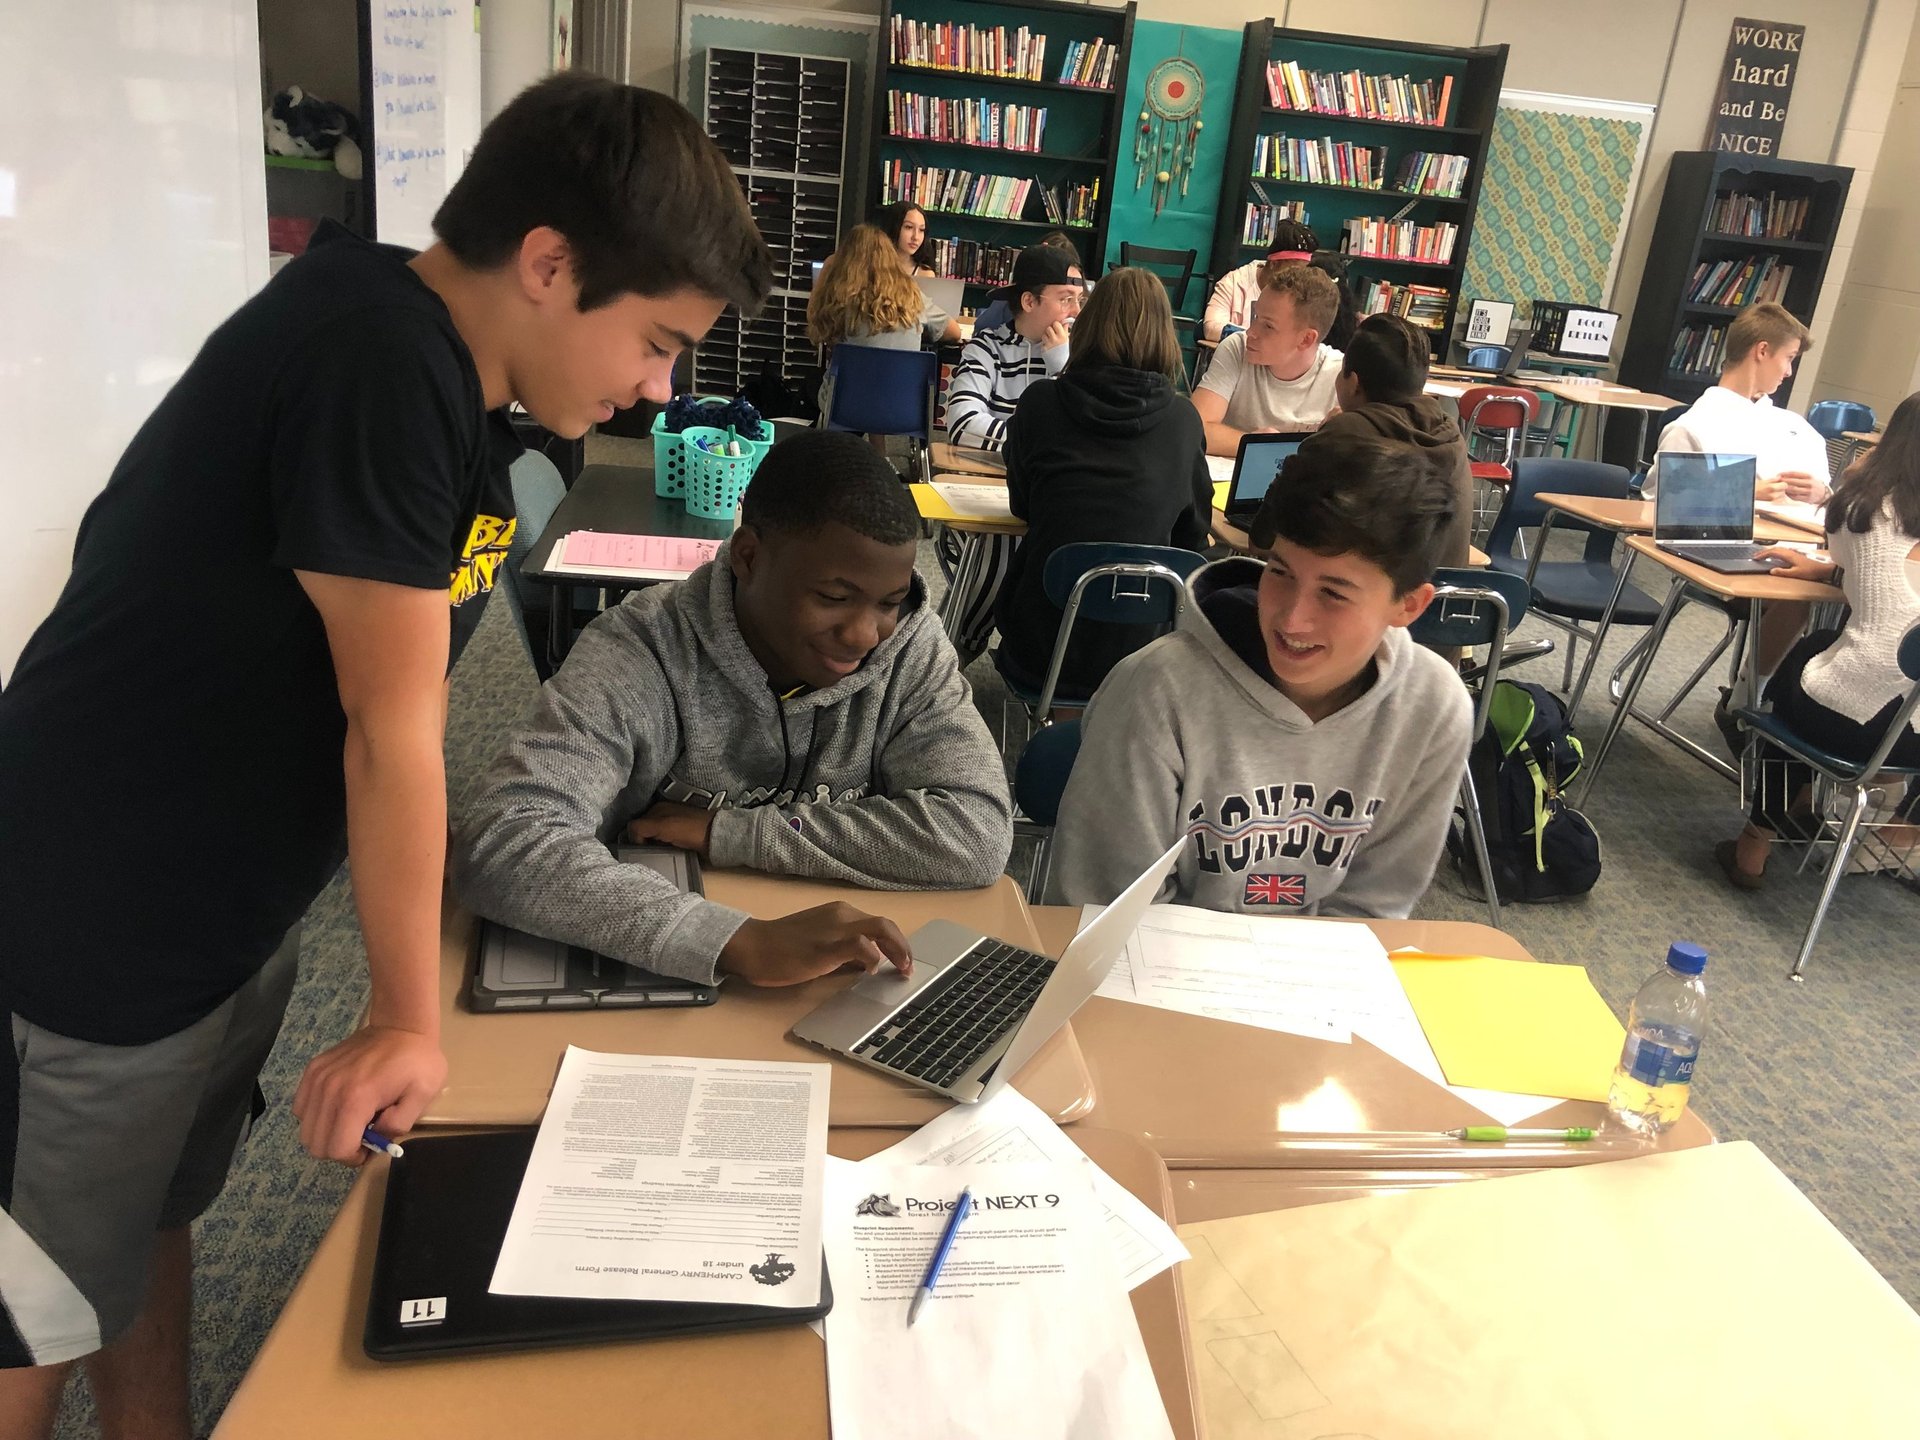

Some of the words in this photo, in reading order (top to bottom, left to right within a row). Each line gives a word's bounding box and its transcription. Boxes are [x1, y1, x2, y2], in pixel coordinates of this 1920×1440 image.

[1734, 25, 1802, 52] WORK
[1731, 57, 1790, 87] hard
[1720, 100, 1755, 118] and
[1760, 102, 1785, 121] Be
[1717, 133, 1772, 155] NICE
[905, 1197, 979, 1212] Projet
[985, 1195, 1038, 1210] NEXT
[1044, 1194, 1060, 1207] 9
[575, 1265, 600, 1273] Form
[681, 1271, 743, 1280] CAMPHENRY
[412, 1300, 435, 1319] 11
